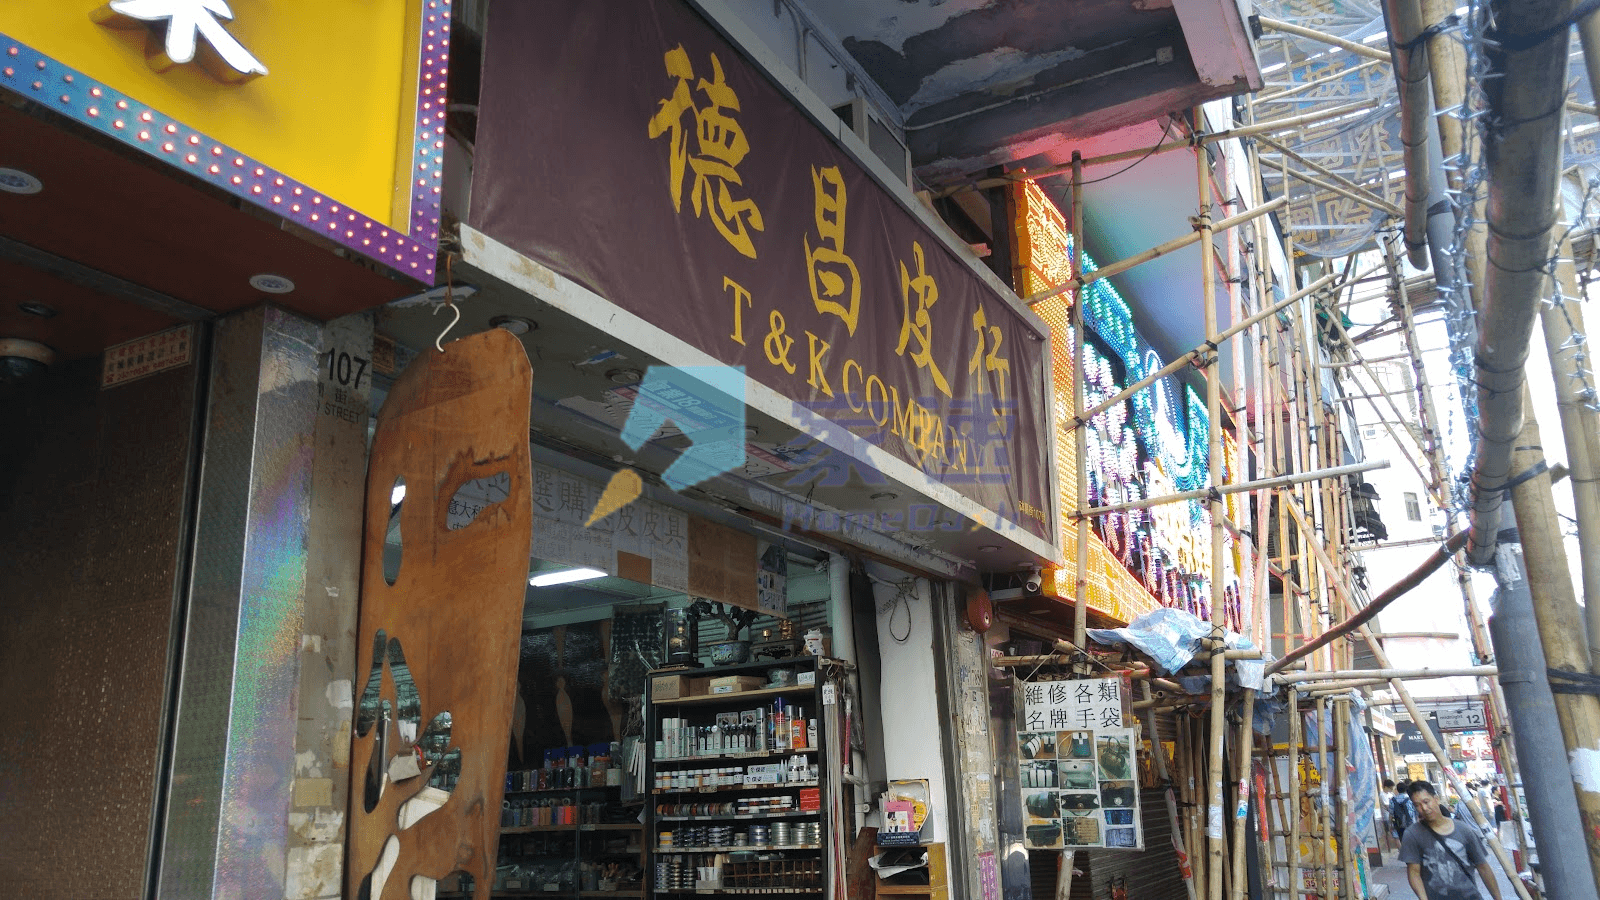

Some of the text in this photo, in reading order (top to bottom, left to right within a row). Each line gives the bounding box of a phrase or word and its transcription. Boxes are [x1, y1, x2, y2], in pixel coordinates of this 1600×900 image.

[648, 44, 1011, 436] 德昌皮行
[326, 347, 368, 389] 107
[723, 276, 985, 484] T & K COMPANY
[324, 402, 361, 425] STREET
[1025, 681, 1120, 706] 維修各類
[1026, 707, 1121, 731] 名牌手袋
[1466, 714, 1481, 724] 12
